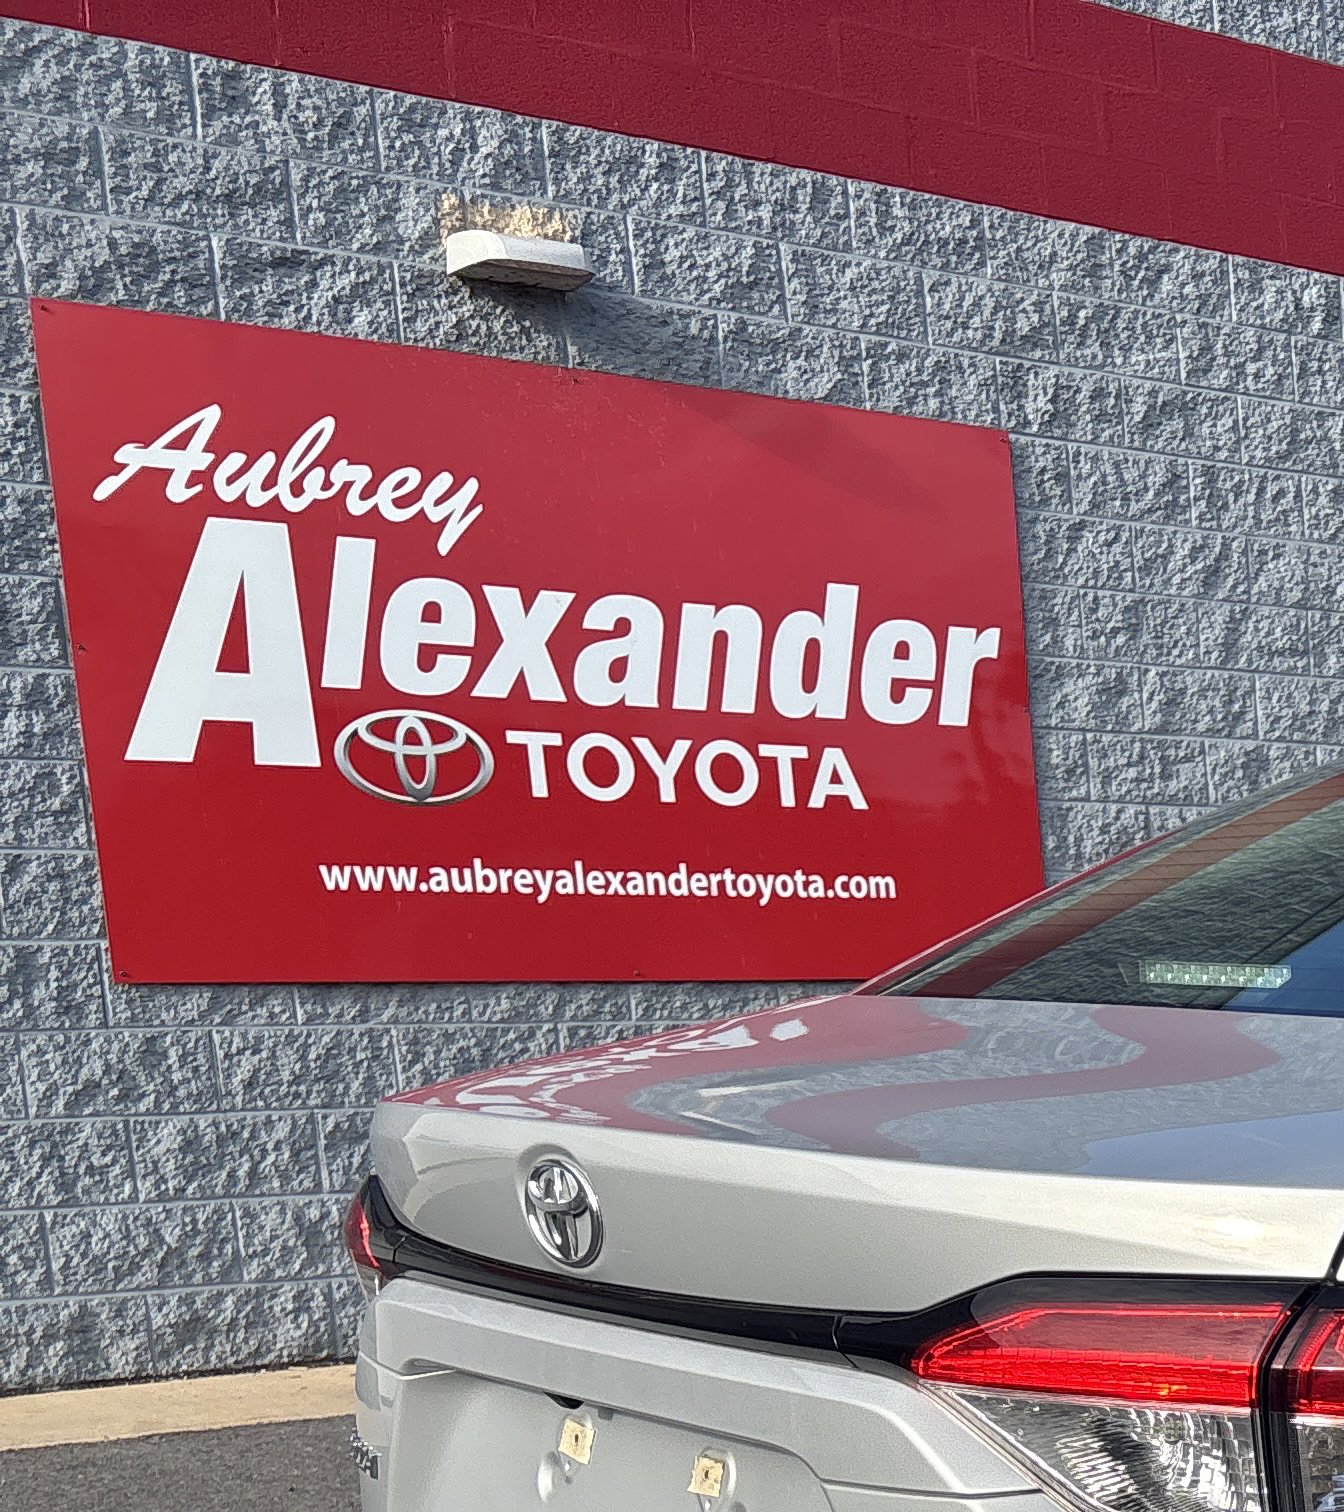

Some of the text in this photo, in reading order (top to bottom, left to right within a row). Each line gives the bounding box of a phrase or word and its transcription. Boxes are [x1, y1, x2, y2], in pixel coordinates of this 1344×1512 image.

[92, 403, 484, 557] Aubrey
[123, 515, 1002, 767] Alexander
[505, 729, 870, 811] TOYOTA
[317, 856, 898, 907] www.aubreyalexandertoyota.com
